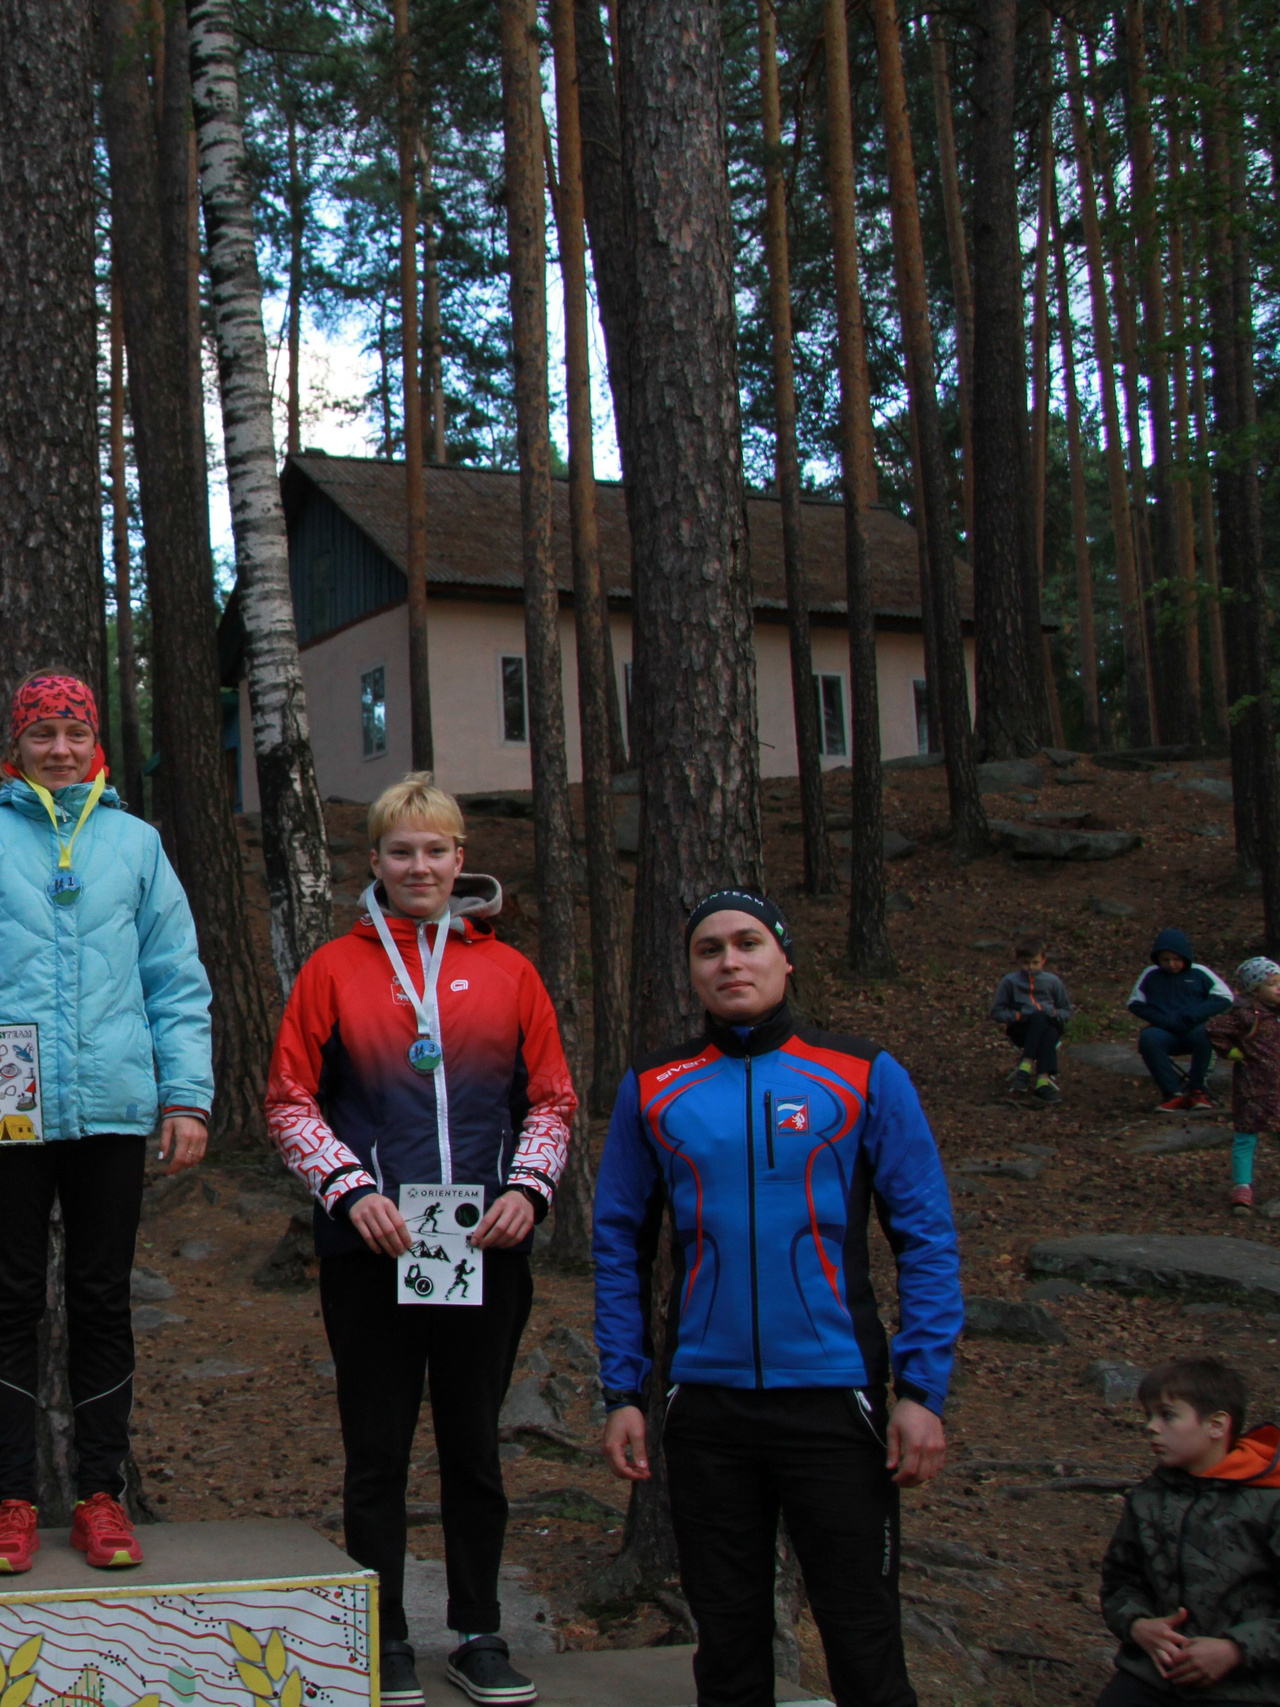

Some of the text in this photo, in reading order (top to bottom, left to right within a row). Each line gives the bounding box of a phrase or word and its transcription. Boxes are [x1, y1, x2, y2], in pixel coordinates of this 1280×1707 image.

[67, 876, 74, 887] 1
[429, 1043, 435, 1053] 3
[421, 1190, 479, 1198] ORIENTEAM
